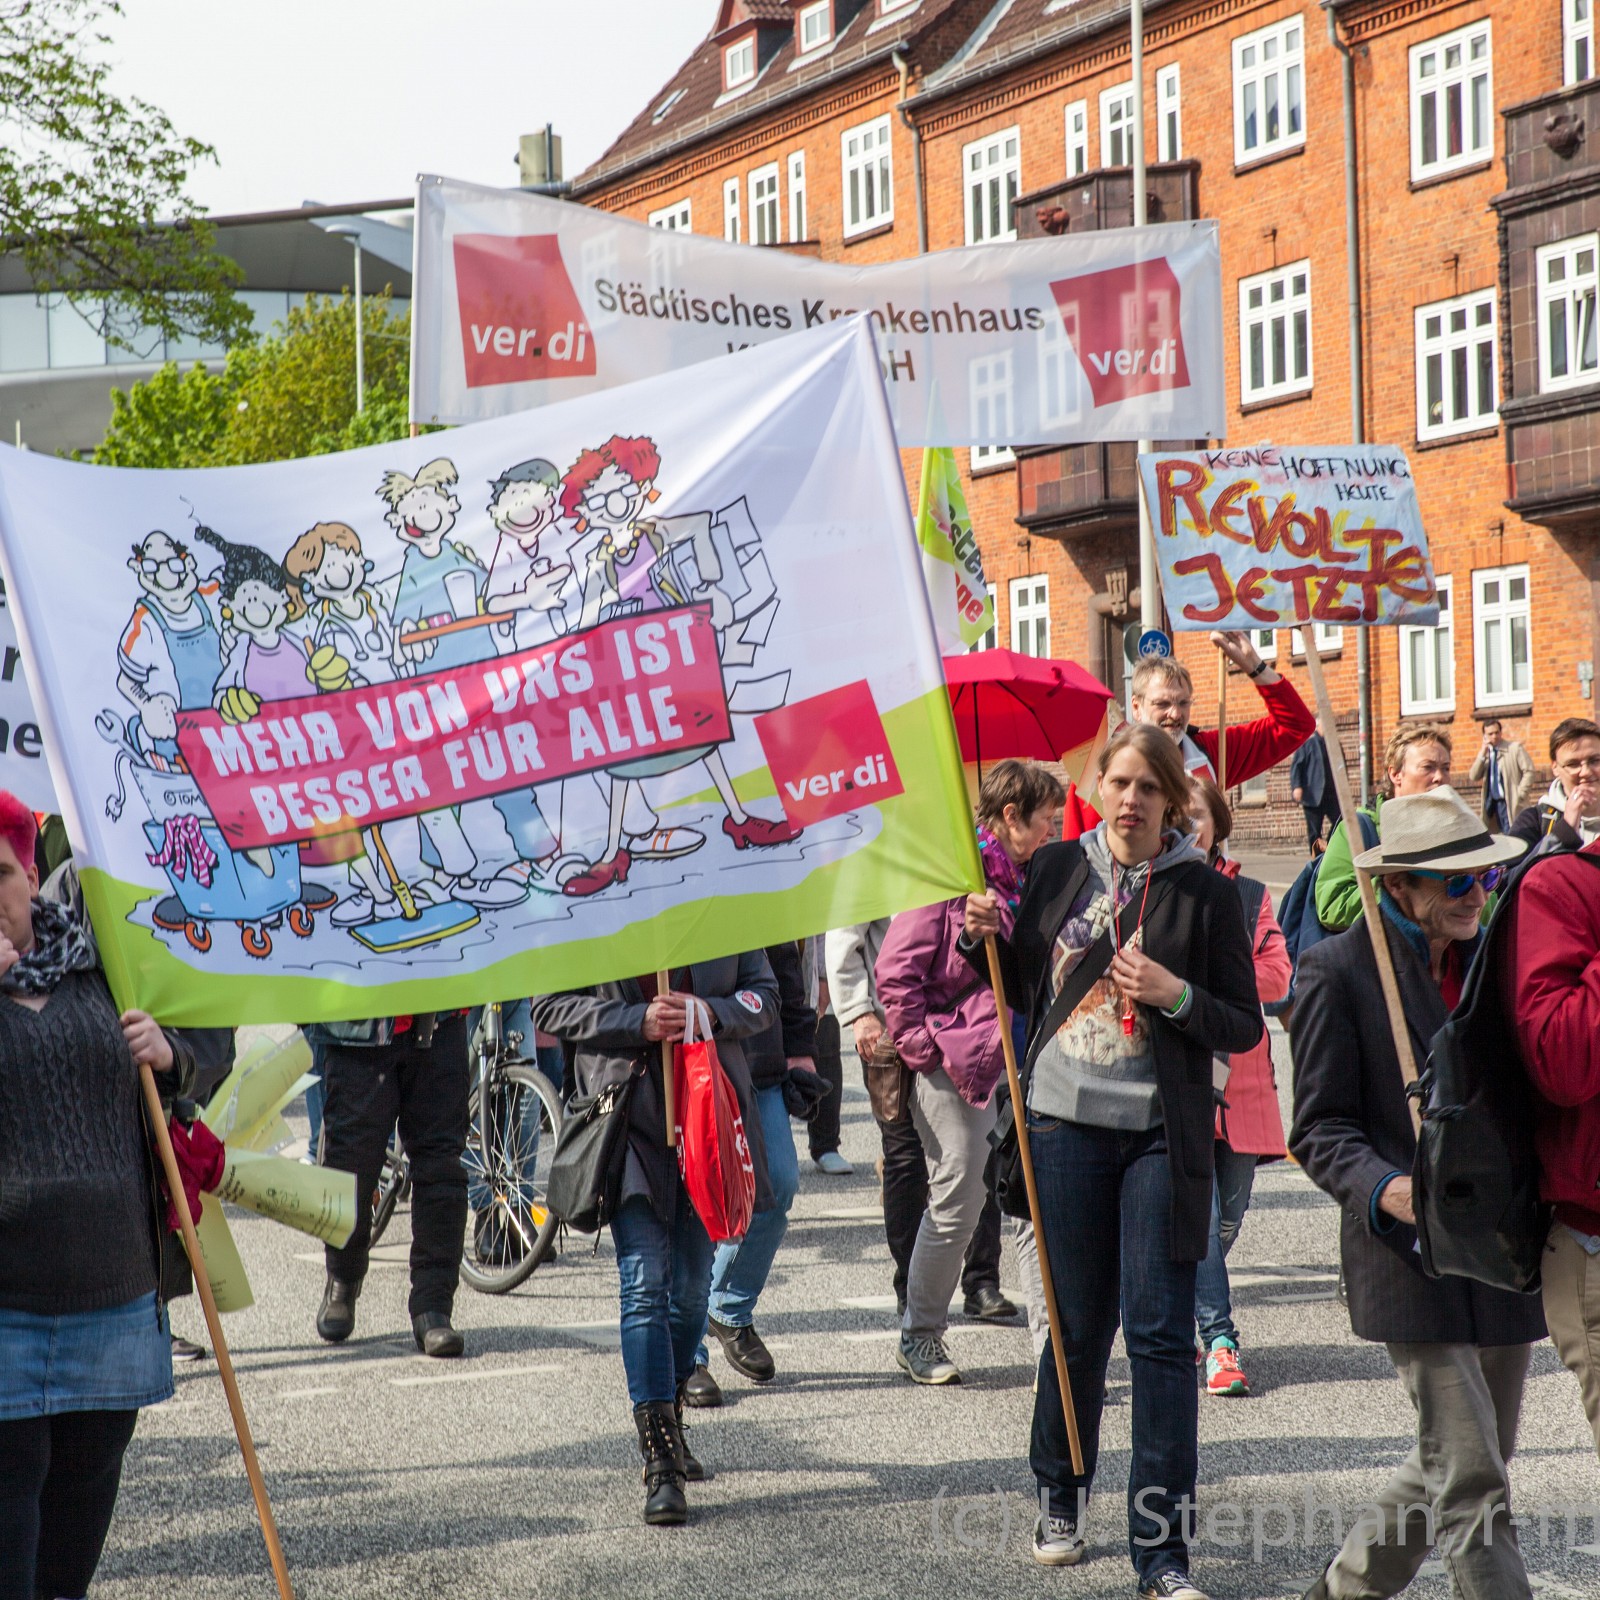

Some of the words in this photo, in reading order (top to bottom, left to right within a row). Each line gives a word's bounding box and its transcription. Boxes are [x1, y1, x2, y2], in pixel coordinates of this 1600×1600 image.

[594, 279, 792, 329] Städtisches
[470, 321, 586, 362] ver.di
[1088, 338, 1177, 375] ver.di
[1279, 456, 1410, 480] HOFFNUNG
[200, 711, 345, 777] MEHR
[356, 680, 469, 750] VON
[483, 641, 594, 714] UNS
[613, 613, 696, 681] IST
[249, 755, 431, 836] BESSER
[442, 726, 546, 790] FÜR
[568, 685, 684, 762] ALLE
[784, 754, 889, 802] ver.di
